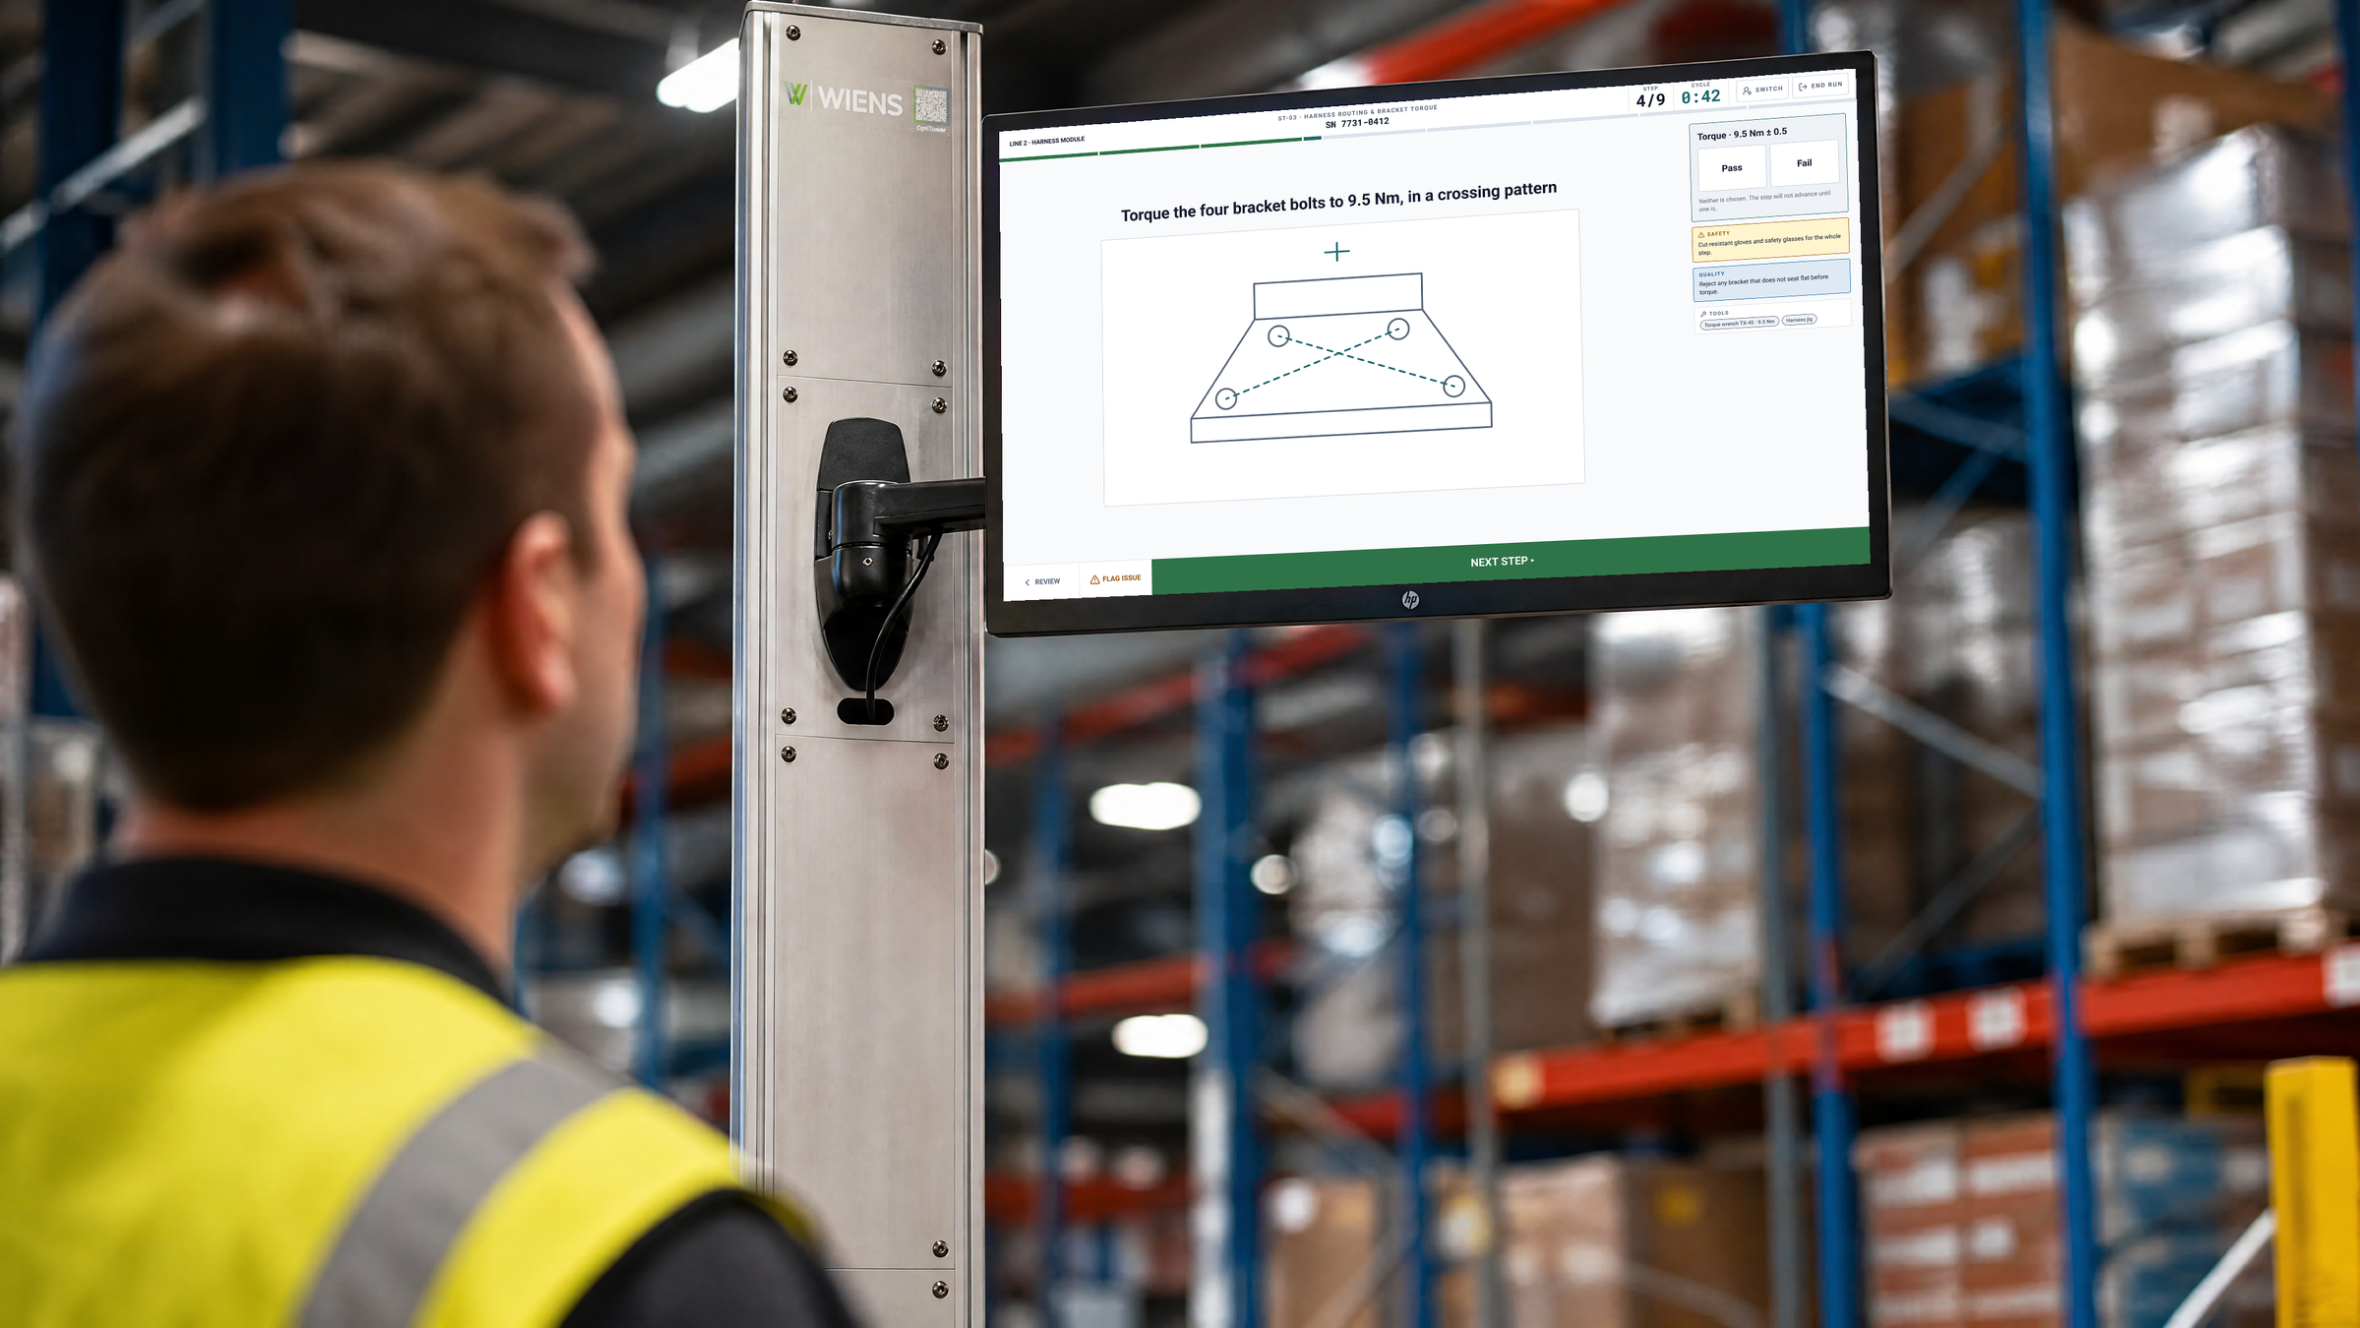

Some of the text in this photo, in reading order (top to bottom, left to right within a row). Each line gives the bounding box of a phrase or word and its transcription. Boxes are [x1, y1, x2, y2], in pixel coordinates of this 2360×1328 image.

[1755, 85, 1783, 93] SWITCH
[817, 85, 904, 117] WIENS
[1636, 92, 1665, 108] 4/9
[1681, 88, 1720, 104] 0:42
[1277, 114, 1297, 122] ST-03
[1303, 111, 1336, 120] HARNESS
[1337, 109, 1368, 117] ROUTING
[1377, 106, 1408, 114] BRACKET
[1410, 104, 1438, 112] TORQUE
[1325, 116, 1390, 129] SN 7731-0412
[1696, 132, 1727, 141] Torque
[1733, 129, 1747, 138] 9.5
[1749, 129, 1764, 137] Nm
[1773, 126, 1787, 136] 0.5
[1031, 137, 1059, 145] HARNESS
[1060, 135, 1085, 143] MODULE
[1721, 164, 1743, 172] Pass
[1796, 158, 1812, 167] Fail
[1120, 182, 1557, 223] Torque the four bracket bolts to 9.5 Nm, in a crossing pattern
[1725, 195, 1747, 203] chosen.
[1697, 240, 1733, 248] Cut-resistant
[1733, 239, 1752, 247] gloves
[1764, 236, 1782, 244] safety
[1782, 236, 1804, 244] glasses
[1810, 273, 1829, 281] before
[1470, 555, 1528, 567] NEXT STEP
[1034, 577, 1060, 585] REVIEW
[1102, 573, 1141, 582] FLAG ISSUE
